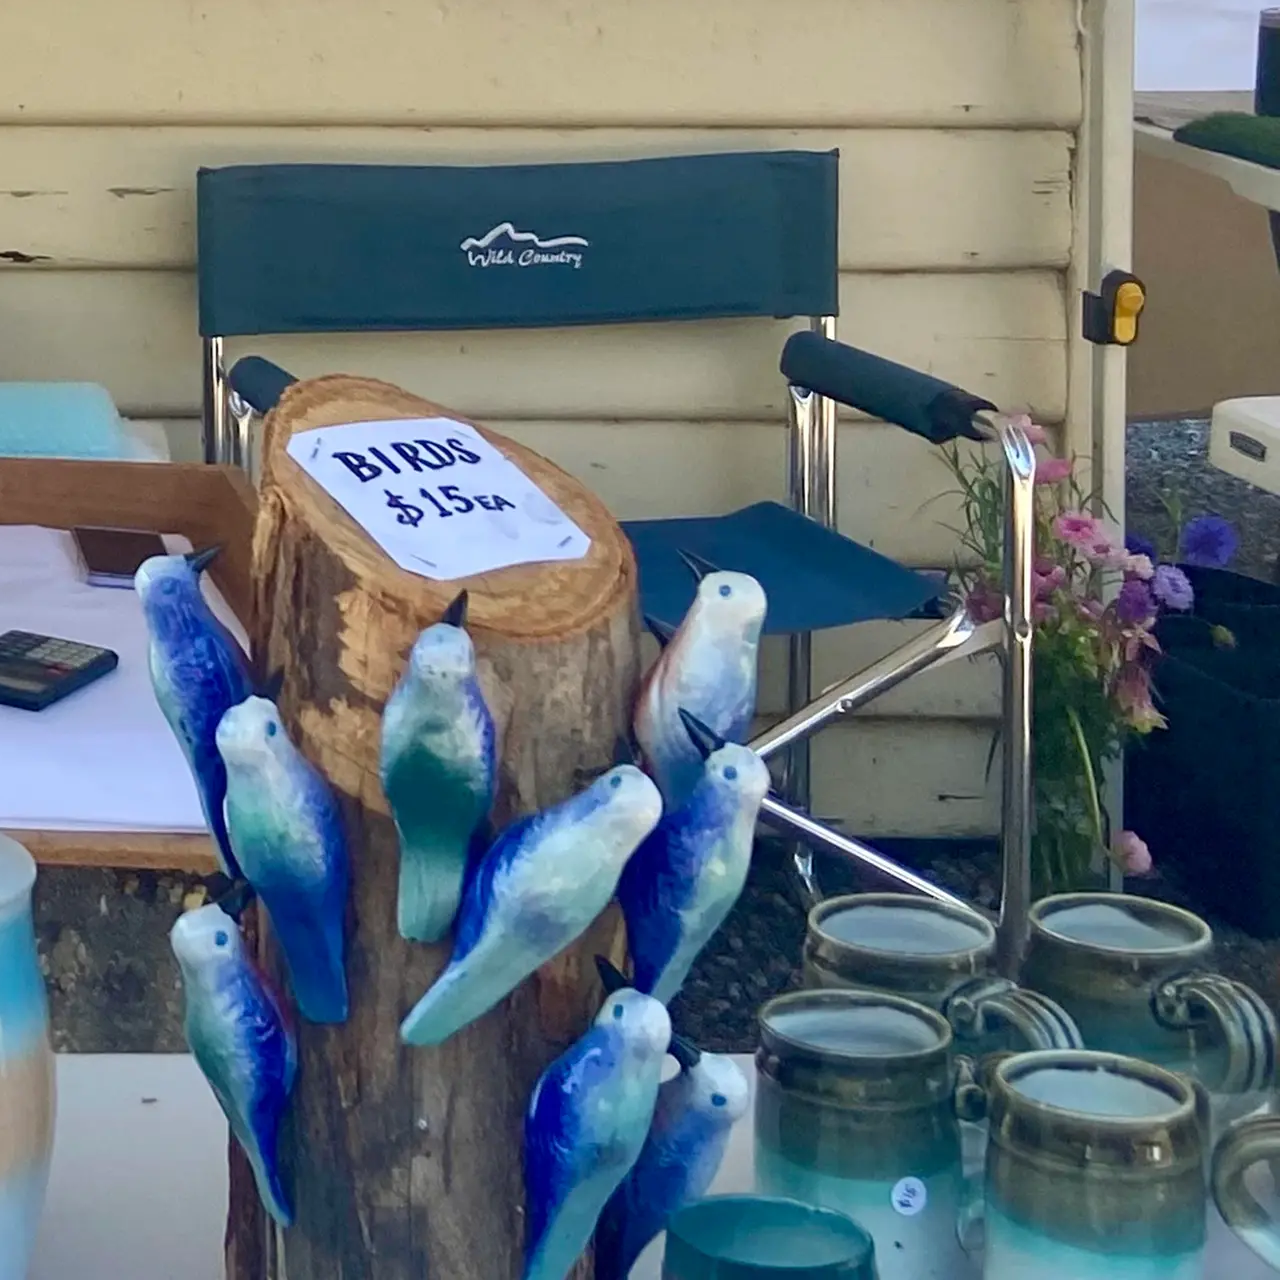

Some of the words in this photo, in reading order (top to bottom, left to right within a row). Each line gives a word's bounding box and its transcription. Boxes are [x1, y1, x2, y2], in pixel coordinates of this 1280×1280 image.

[468, 249, 514, 267] Wild
[518, 249, 582, 269] Country
[331, 438, 481, 483] BIRDS
